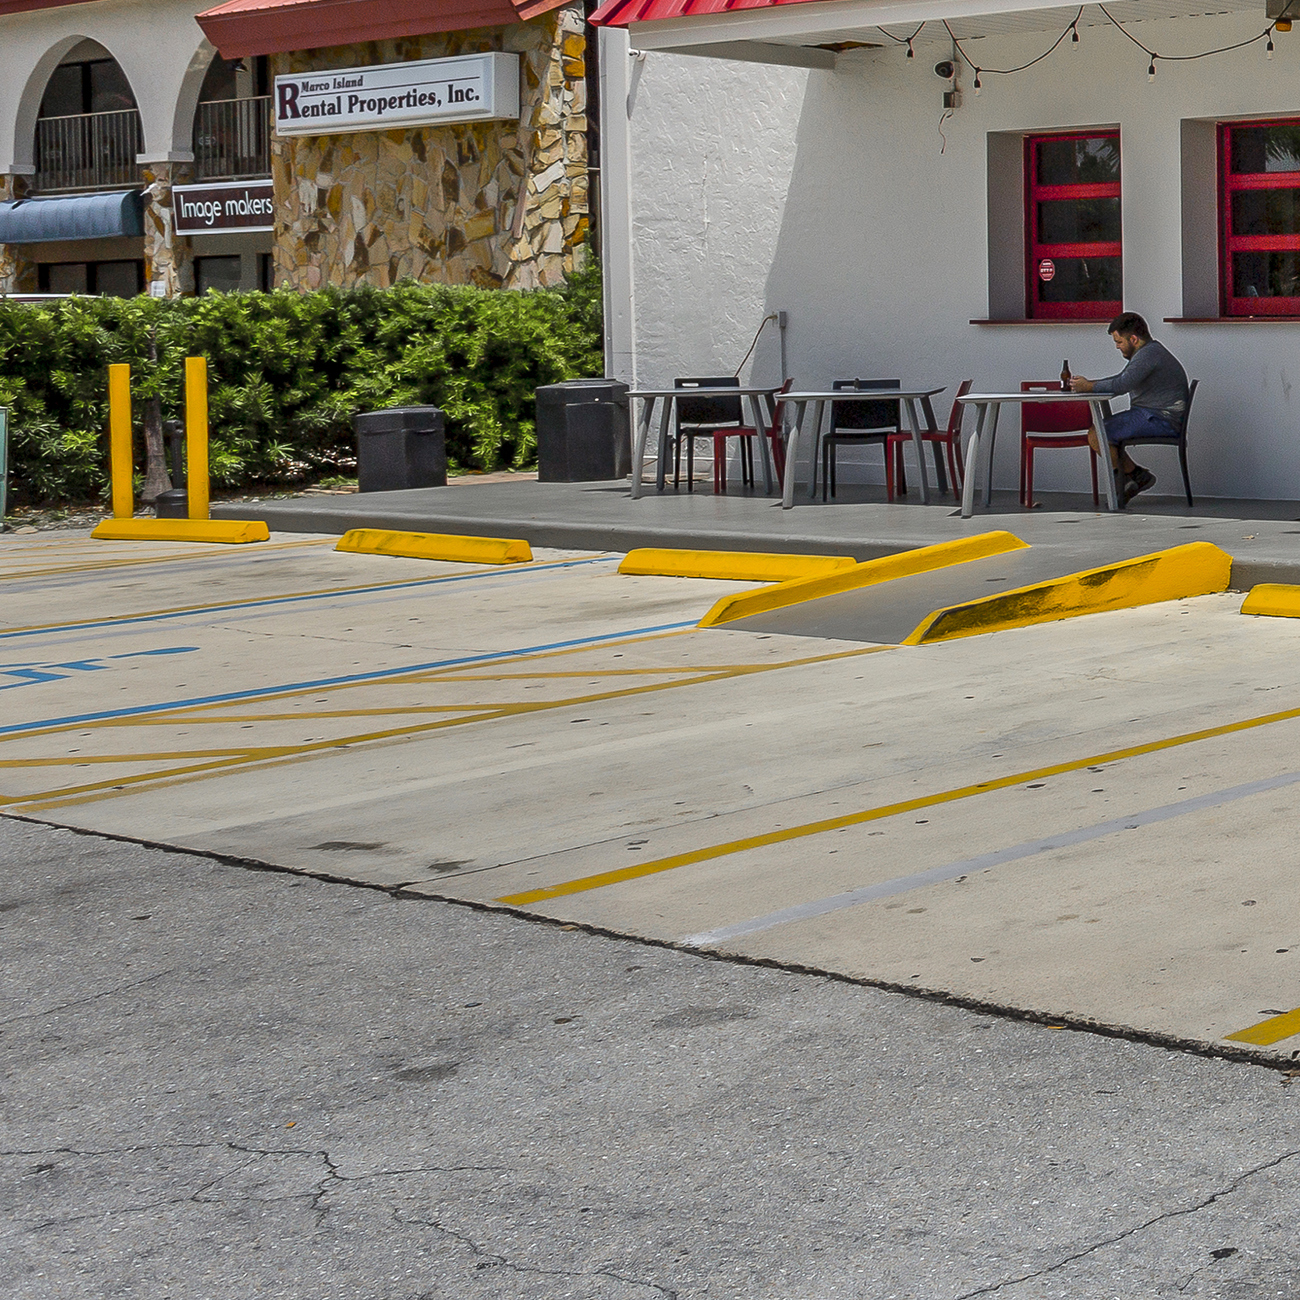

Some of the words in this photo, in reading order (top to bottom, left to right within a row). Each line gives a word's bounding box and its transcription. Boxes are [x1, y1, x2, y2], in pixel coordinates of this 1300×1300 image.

[301, 81, 330, 93] Marco
[333, 75, 364, 89] Island
[277, 83, 342, 120] Rental
[347, 88, 442, 115] Properties,
[447, 84, 480, 103] Inc.
[180, 194, 222, 225] Image
[225, 191, 273, 215] makers
